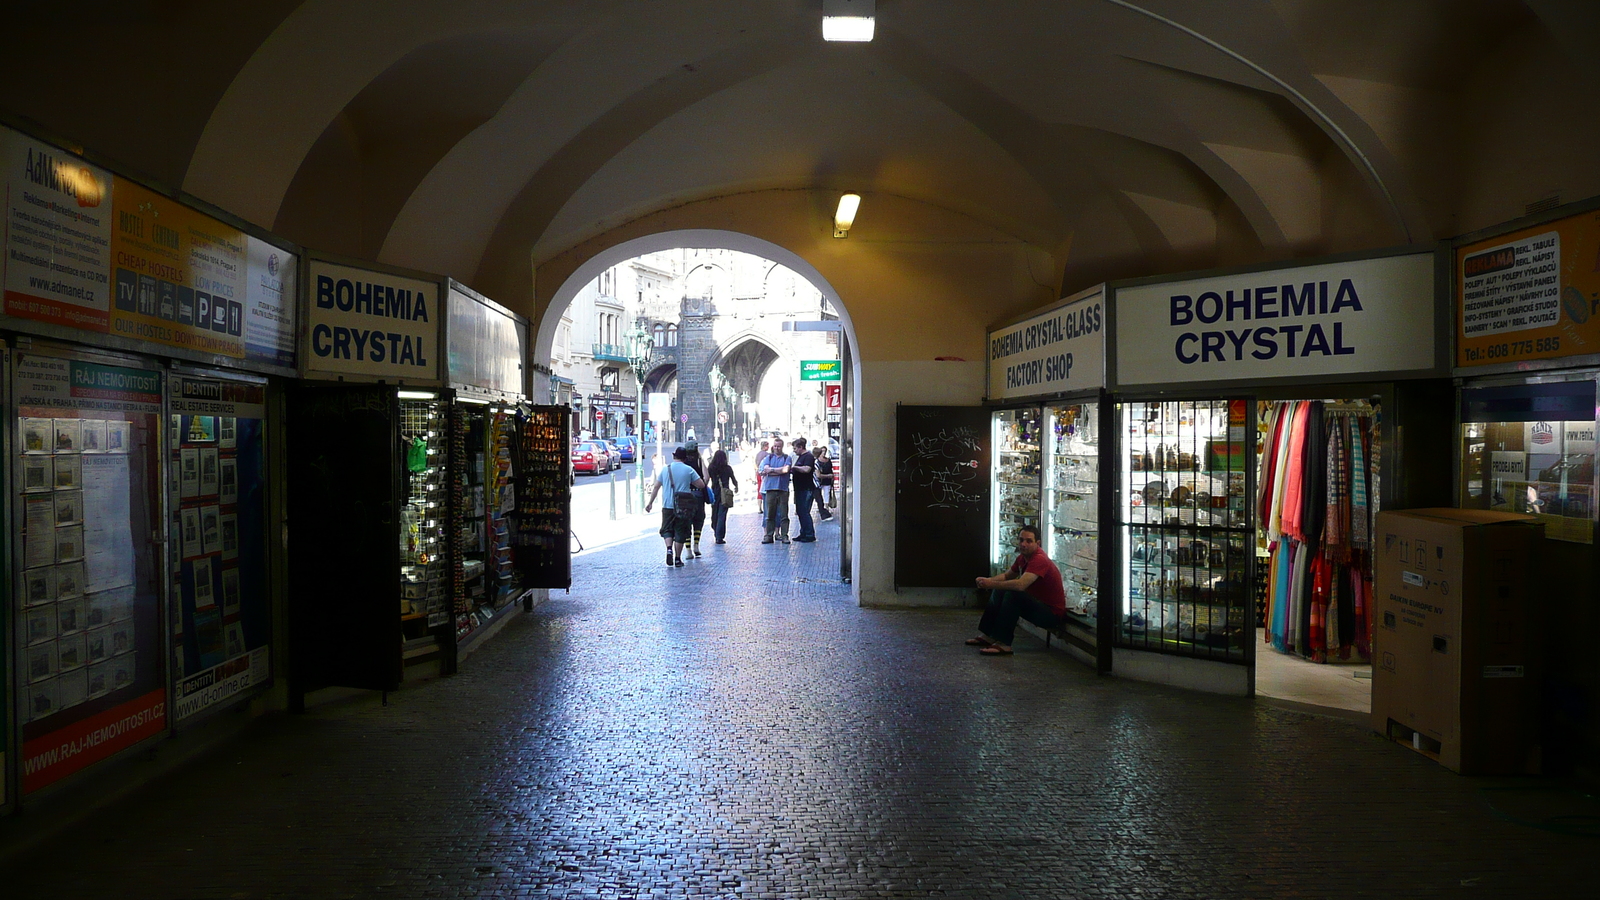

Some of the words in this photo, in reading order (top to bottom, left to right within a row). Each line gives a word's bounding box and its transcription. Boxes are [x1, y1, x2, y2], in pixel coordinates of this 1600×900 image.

[13, 208, 30, 221] Tvorba
[23, 191, 48, 209] Reklama
[51, 201, 78, 222] Marketing
[80, 213, 99, 227] Internet
[120, 210, 144, 239] HOSTEL
[152, 222, 180, 252] CENTRUM
[1515, 247, 1531, 256] REKL.
[1532, 238, 1555, 251] TABULE
[1515, 259, 1531, 268] REKL.
[1532, 250, 1556, 264] NÁPISY
[50, 262, 79, 277] prezentace
[80, 270, 87, 280] na
[87, 270, 95, 281] CD
[96, 272, 108, 285] ROM
[118, 251, 147, 274] CHEAP
[148, 261, 183, 282] HOSTELS
[220, 259, 233, 271] Prague
[1464, 279, 1485, 290] POLEPY
[1486, 275, 1498, 286] AUT
[1501, 270, 1523, 282] POLEPY
[1523, 260, 1557, 277] VÝKLADCŮ
[1465, 250, 1514, 275] REKLAMA
[29, 276, 95, 302] www.admanet.cz
[119, 281, 135, 302] TV
[195, 275, 211, 291] LOW
[212, 280, 234, 298] PRICES
[317, 275, 429, 323] BOHEMIA
[1464, 287, 1486, 301] FIREMNÍ
[1485, 284, 1502, 297] ŠTÍTY
[1505, 277, 1533, 292] VÝSTAVNÍ
[1533, 275, 1557, 287] PANELY
[199, 297, 209, 324] P
[1170, 279, 1363, 326] BOHEMIA
[1464, 297, 1494, 312] FRÉZOVANÉ
[1494, 293, 1515, 305] NÁPISY
[1519, 290, 1544, 302] NÁVRHY
[1544, 287, 1558, 297] LOG
[1506, 301, 1534, 315] GRAFICKÉ
[1534, 299, 1558, 311] STUDIO
[8, 300, 28, 312] mobil:
[65, 308, 108, 327] info@admanet.cz
[1464, 323, 1489, 334] BANNERY
[1492, 320, 1508, 330] SCAN
[1512, 317, 1528, 327] REKL.
[1528, 310, 1557, 324] POUTAČE
[115, 318, 134, 334] OUR
[136, 323, 172, 342] HOSTELS
[174, 330, 217, 350] DOWNTOWN
[219, 341, 243, 355] PRAGUE
[312, 323, 426, 367] CRYSTAL
[992, 330, 1024, 361] BOHEMIA
[1175, 322, 1355, 364] CRYSTAL
[1464, 345, 1485, 361] Tel.:
[1487, 343, 1508, 359] 608
[1511, 339, 1533, 355] 775
[1535, 336, 1560, 353] 585
[75, 366, 95, 384] RÁJ
[803, 363, 836, 371] SUBWAY
[808, 372, 820, 380] eat
[1007, 358, 1044, 389] FACTORY
[1045, 352, 1073, 382] SHOP
[183, 381, 219, 398] IDENTITY
[53, 398, 72, 407] PRAHA
[95, 400, 103, 409] NA
[103, 401, 122, 410] STANICI
[122, 402, 138, 411] METRA
[145, 404, 159, 413] FLORA
[171, 400, 187, 411] REAL
[188, 401, 209, 412] ESTATE
[209, 403, 235, 414] SERVICES
[1492, 460, 1511, 473] PRODEJ
[1511, 459, 1524, 474] BYTŮ
[1389, 593, 1409, 605] DAIKIN
[1409, 598, 1433, 613] EUROPE
[1433, 606, 1444, 615] NV
[183, 671, 213, 694] IDENTITY
[177, 674, 249, 720] www.id-online.cz
[24, 702, 165, 777] WWW.RAJ-NEMOVITOSTI.CZ
